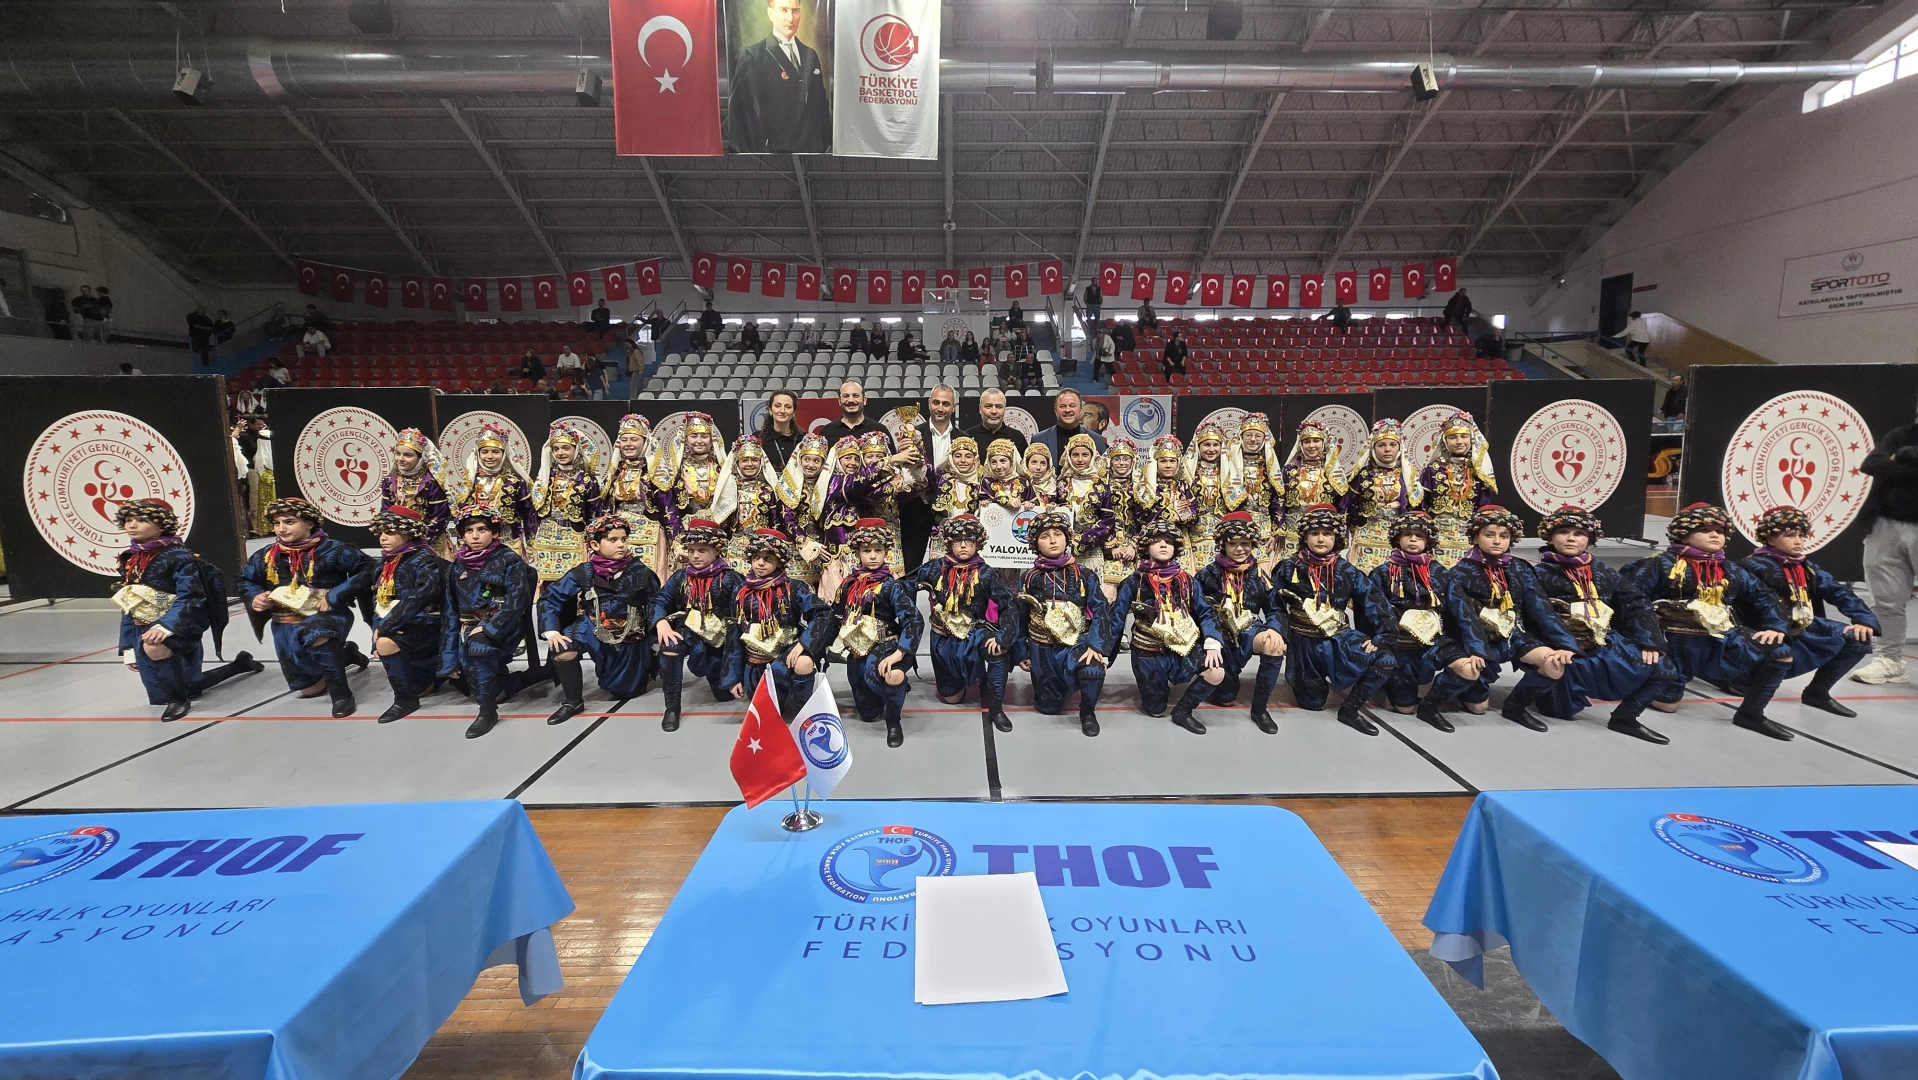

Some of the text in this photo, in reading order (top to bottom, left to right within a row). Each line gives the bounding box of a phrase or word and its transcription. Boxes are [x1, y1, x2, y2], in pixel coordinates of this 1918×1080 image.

[859, 74, 918, 89] TÜRKİYE
[859, 87, 918, 98] BASKETBOL
[858, 96, 918, 105] FEDERASYONU
[340, 430, 370, 441] GENÇLİK
[1790, 422, 1824, 436] GENÇLİK
[1824, 434, 1834, 446] VE
[316, 433, 339, 478] CUMHURİYETİ
[370, 439, 378, 450] VE
[1756, 424, 1788, 485] CUMHURİYETİ
[378, 450, 388, 469] SPOR
[1534, 422, 1604, 494] TÜRKİYE CUMHURİYETİ GENÇLİK VE SPOR BAKANLIĞI
[1828, 445, 1840, 473] SPOR
[57, 443, 160, 543] TÜRKİYE CUMHURİYETİ GENÇLİK VE SPOR
[320, 479, 346, 502] TÜRKİYE
[1807, 475, 1838, 520] BAKANLIĞ
[990, 545, 1028, 554] YALOVA
[89, 833, 366, 880] THOF
[824, 856, 833, 874] DANCE
[972, 844, 1221, 888] THOF
[1702, 858, 1780, 883] FEDERATION
[826, 874, 866, 902] FEDERATION
[872, 890, 916, 902] RASYONU
[0, 898, 276, 922] HALK OYUNLARI
[1765, 893, 1917, 910] TÜRKİYE
[0, 920, 244, 945] ASYONU
[813, 914, 912, 931] TÜRKİ
[1071, 917, 1248, 935] OYUNLARI
[802, 940, 1257, 963] FEDSYONU
